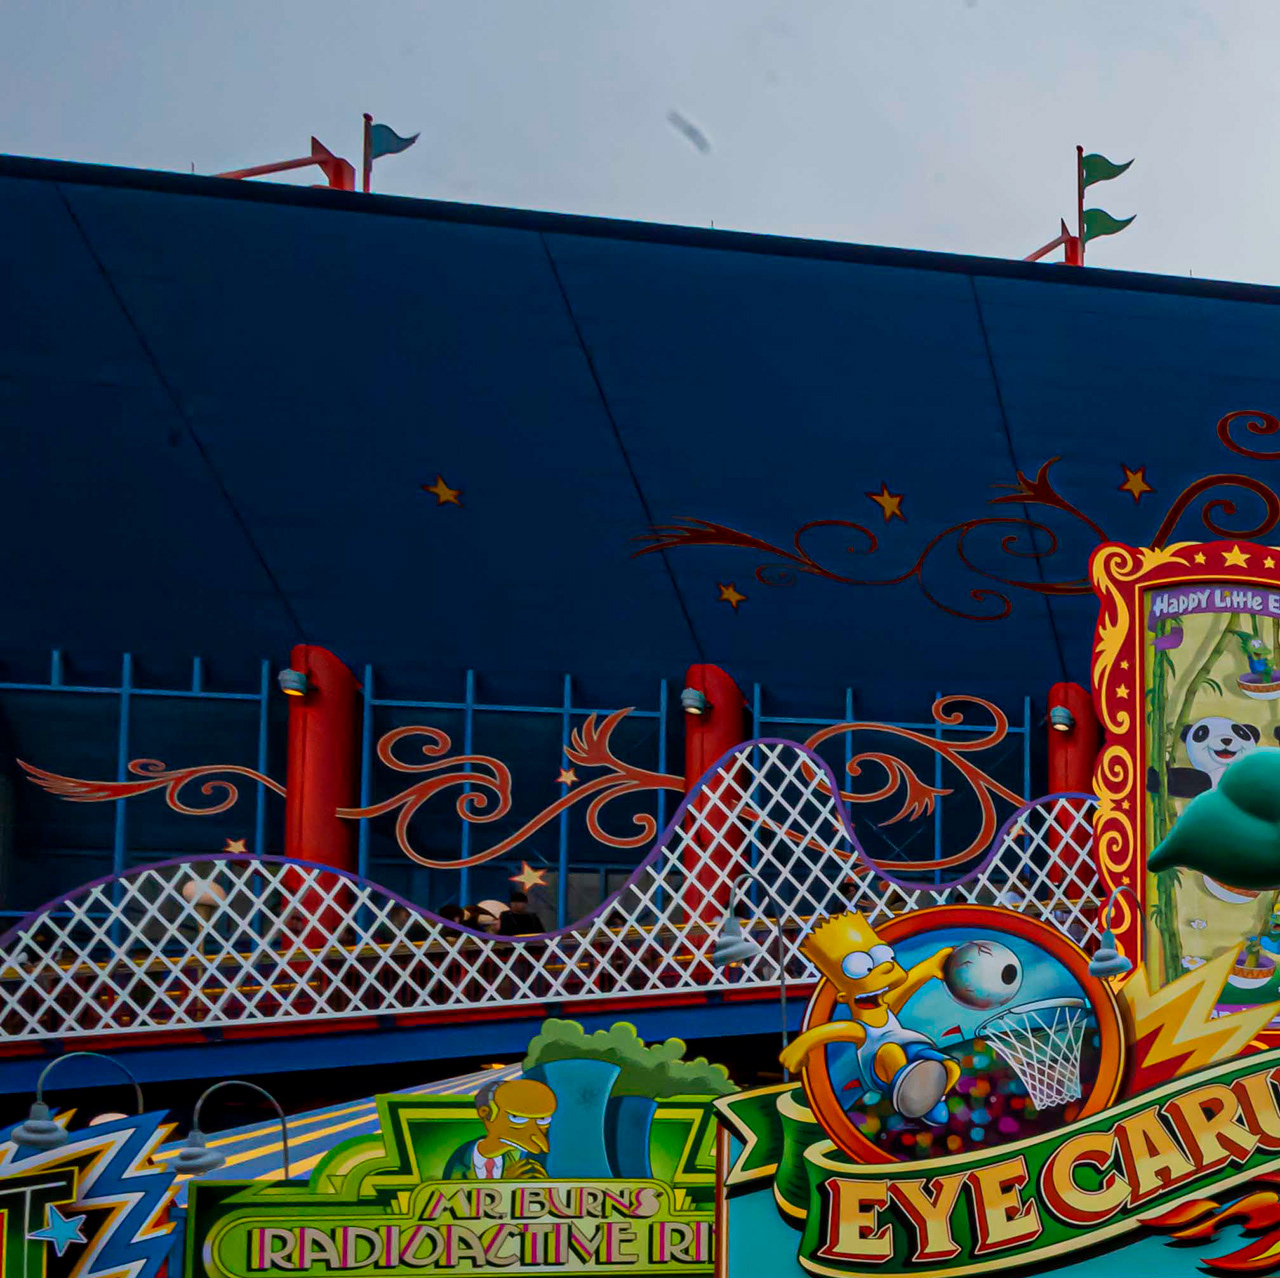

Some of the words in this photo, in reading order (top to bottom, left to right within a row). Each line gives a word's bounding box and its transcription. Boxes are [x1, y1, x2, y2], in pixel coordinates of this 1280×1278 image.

[248, 1221, 640, 1270] RADIOACTIVE
[648, 1221, 715, 1265] RI
[817, 1155, 1043, 1264] EYE
